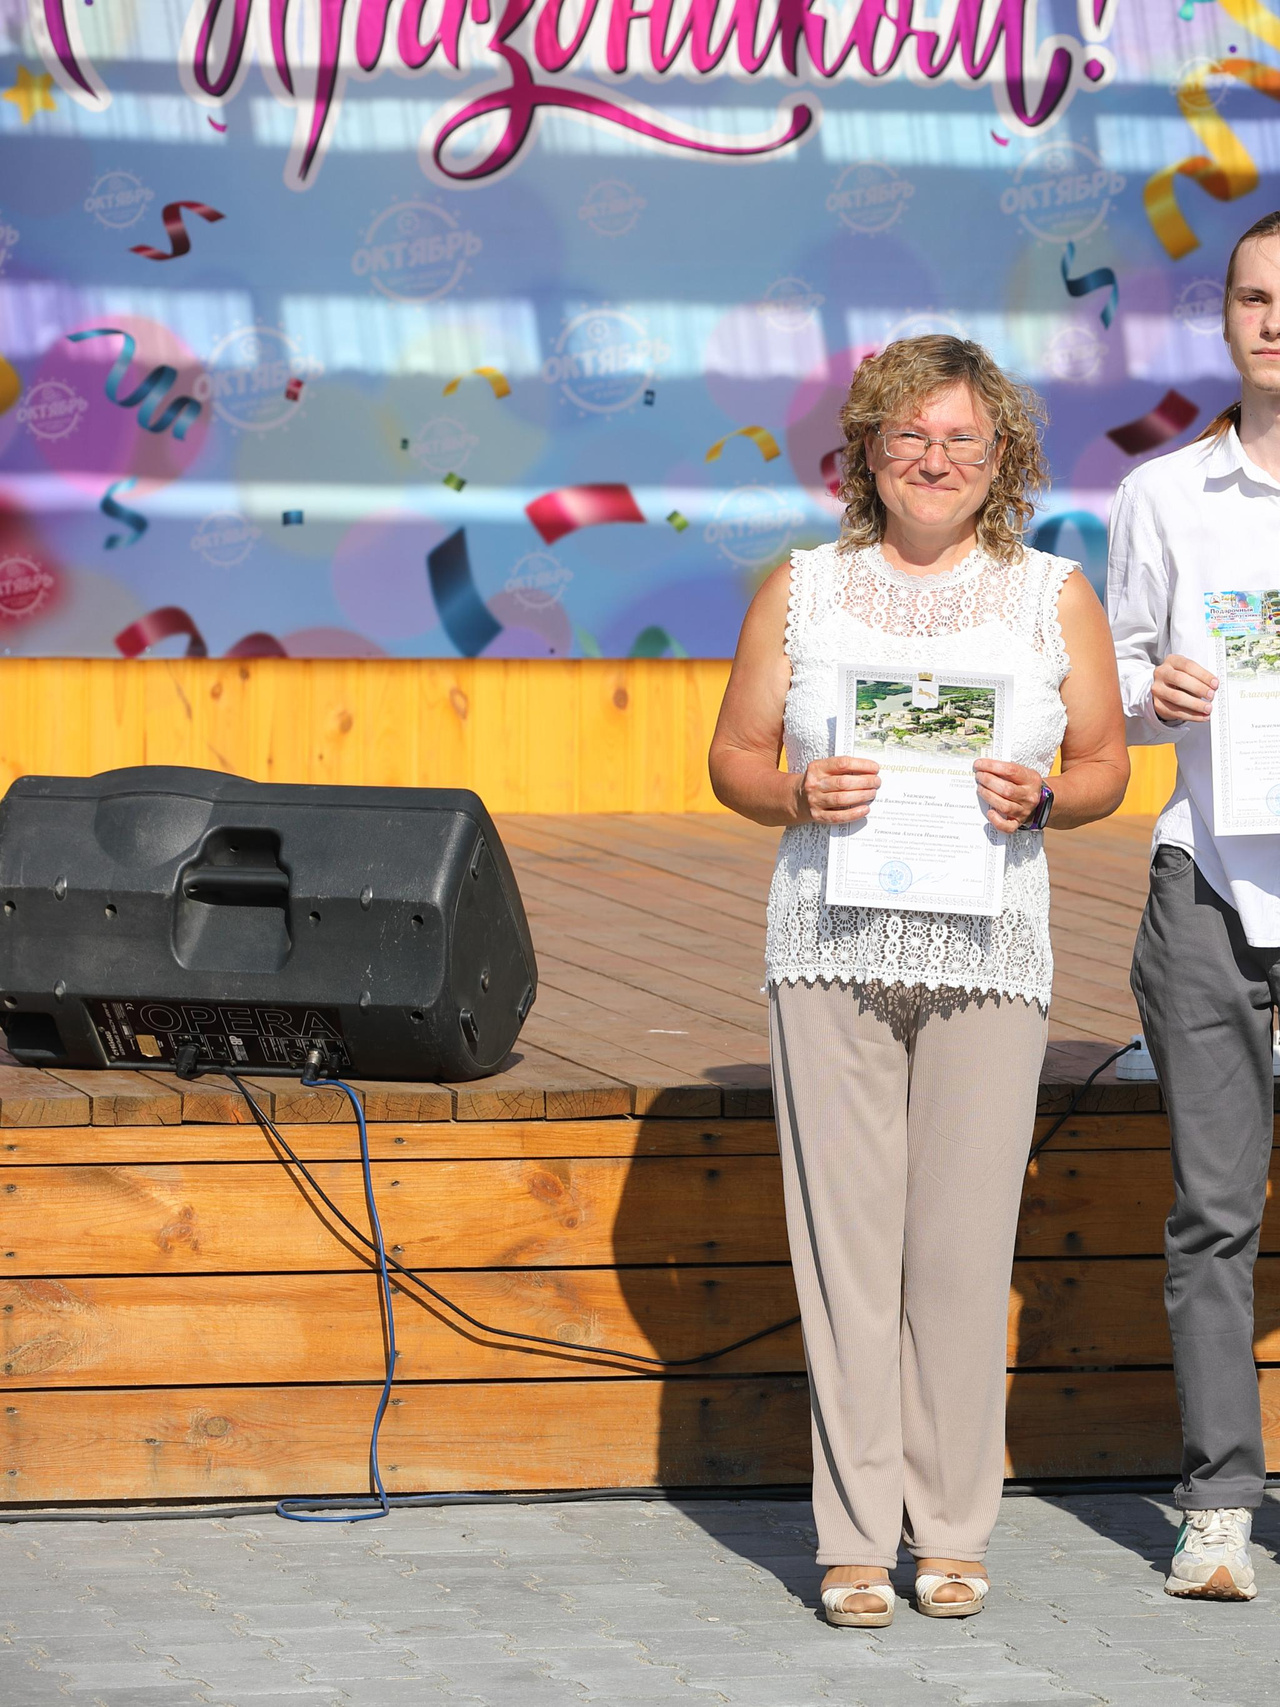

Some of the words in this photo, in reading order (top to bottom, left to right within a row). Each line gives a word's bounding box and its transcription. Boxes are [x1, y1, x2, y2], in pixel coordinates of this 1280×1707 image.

[83, 187, 155, 214] ОКТЯБРЬ
[826, 179, 916, 212] ОКТЯБРЬ
[999, 170, 1127, 215] ОКТЯБРЬ
[351, 230, 483, 276] ОКТЯБРЬ
[192, 353, 325, 400] ОКТЯБРЬ
[541, 337, 671, 384] ОКТЯБРЬ
[16, 397, 89, 423] ОКТЯБРЬ
[703, 507, 806, 544] ОКТЯБРЬ
[878, 763, 946, 777] годарственное
[140, 1004, 342, 1039] OPERA
